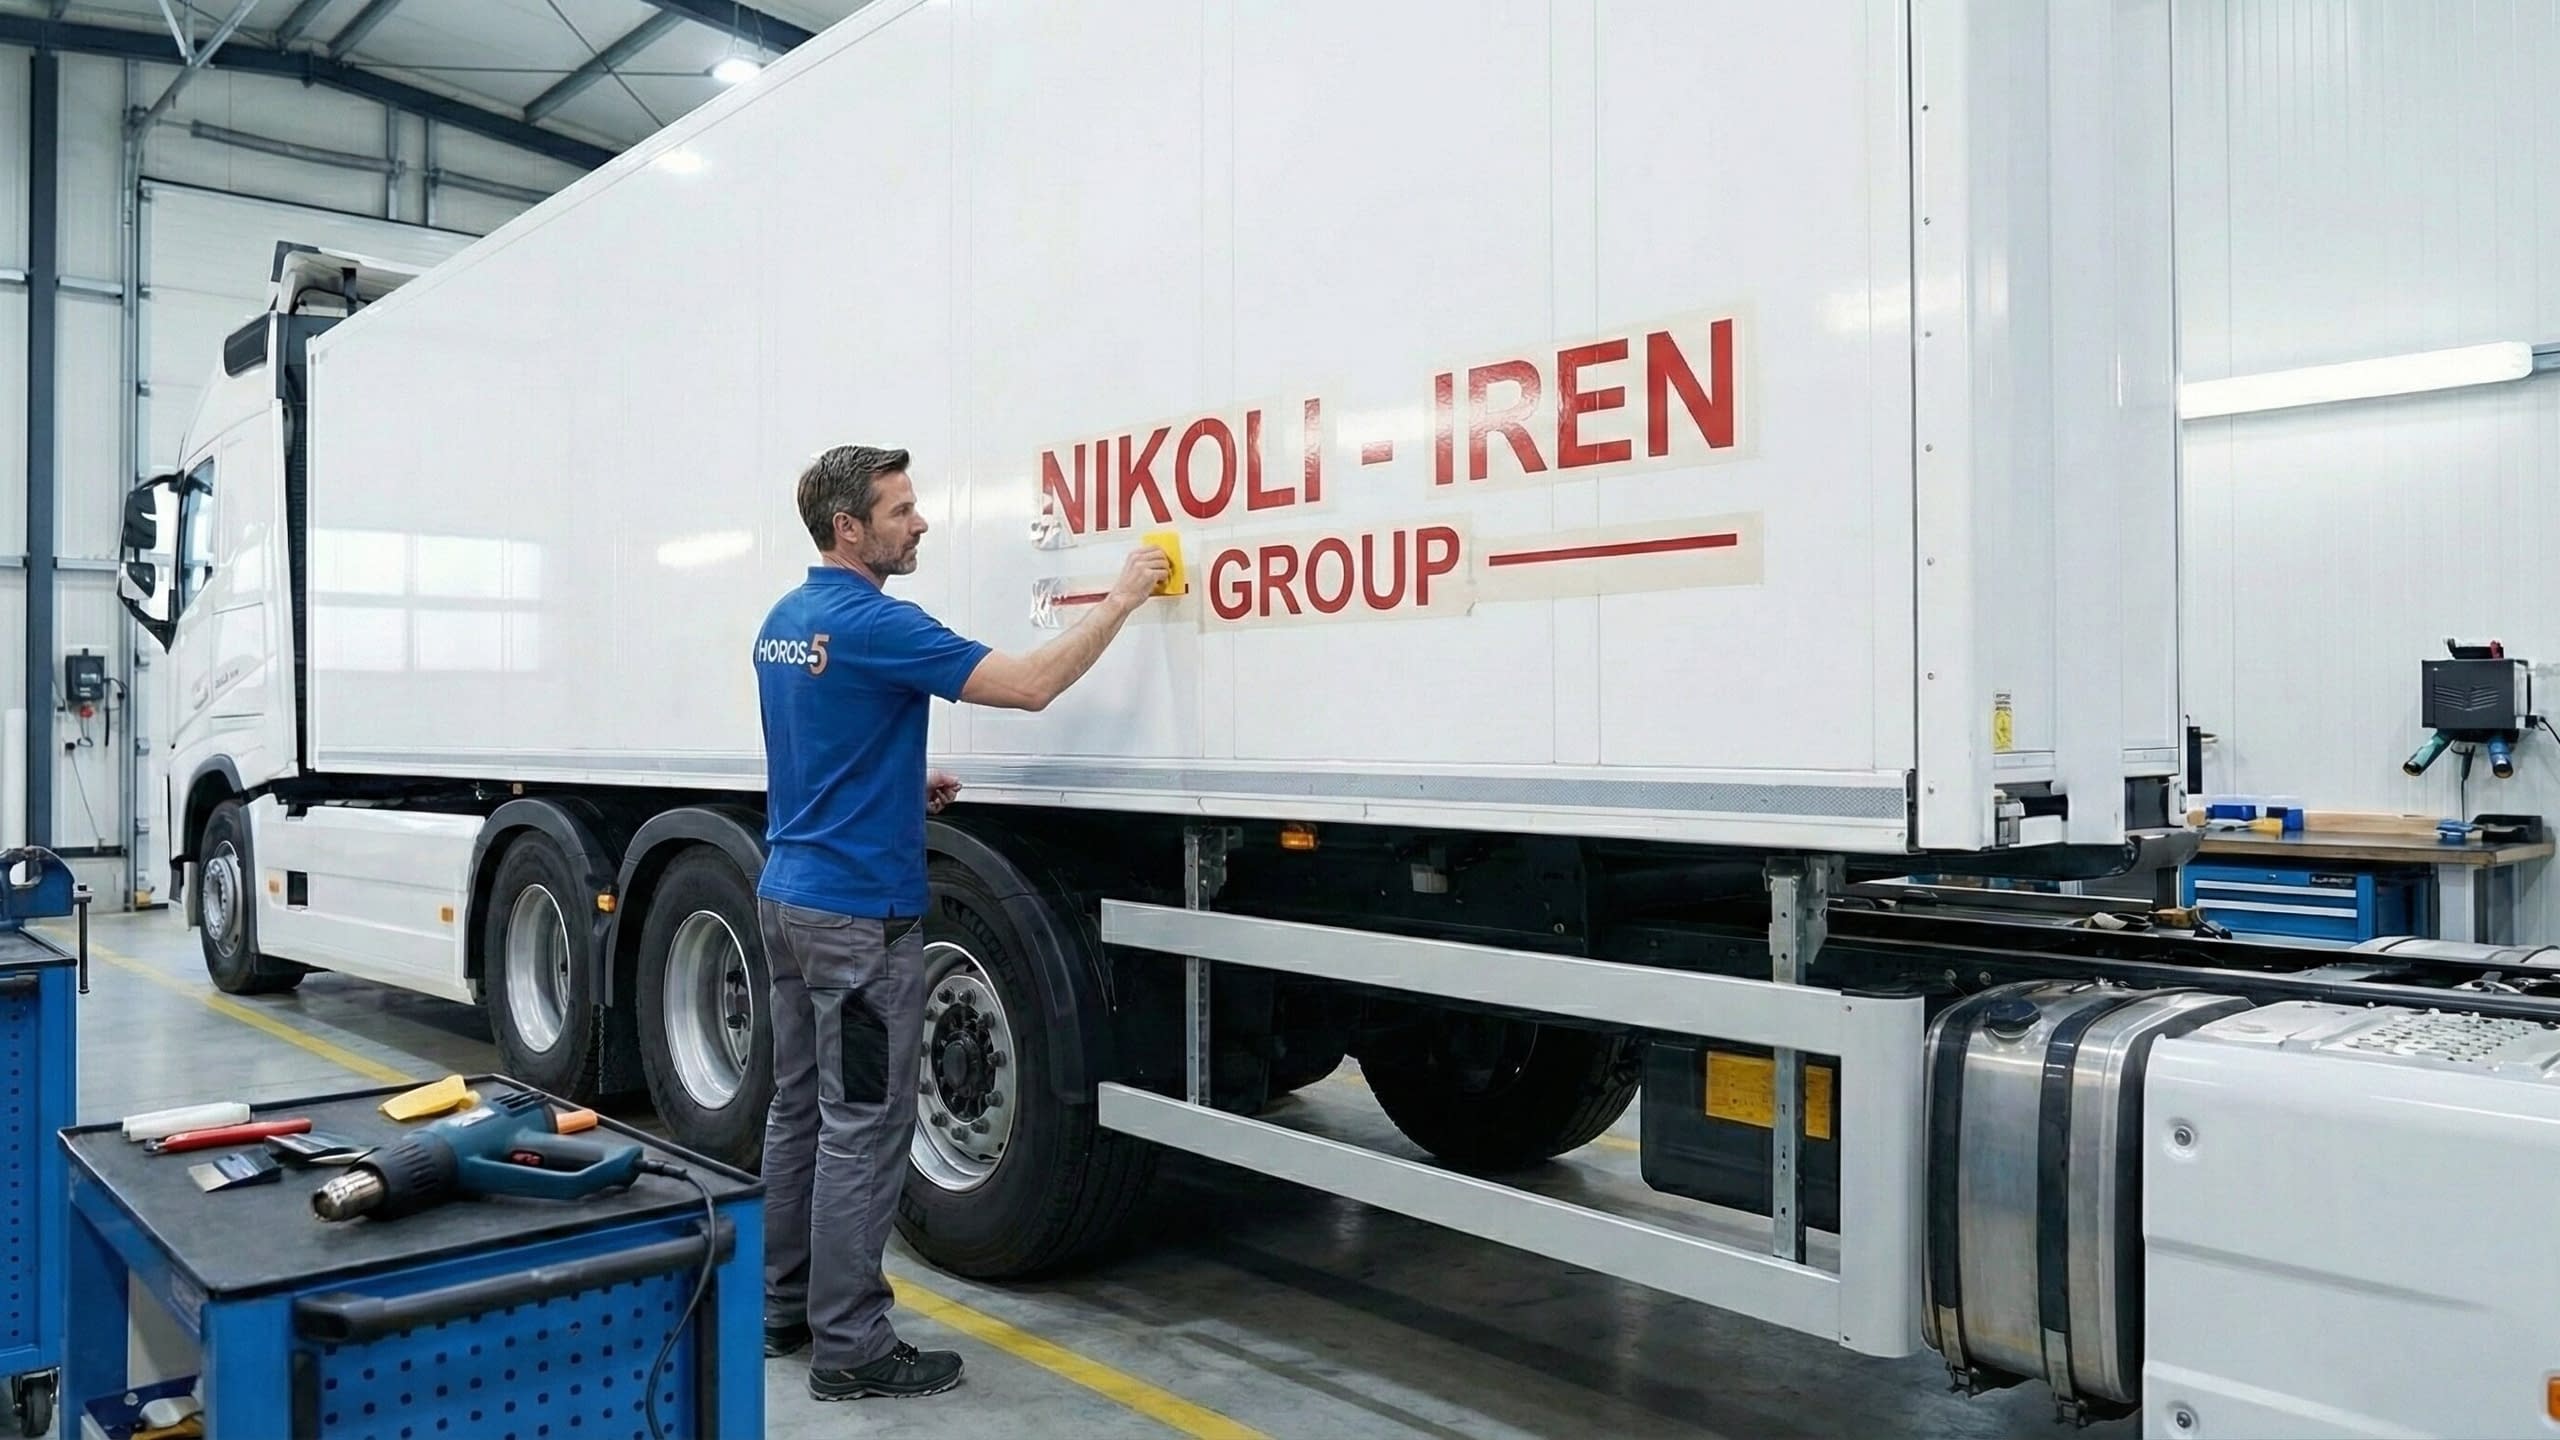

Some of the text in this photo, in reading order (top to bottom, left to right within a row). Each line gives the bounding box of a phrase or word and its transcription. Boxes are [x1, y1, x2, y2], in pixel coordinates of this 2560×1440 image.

[1042, 398, 1321, 535] NIKOLI
[1434, 318, 1734, 485] IREN
[1209, 526, 1461, 621] GROUP
